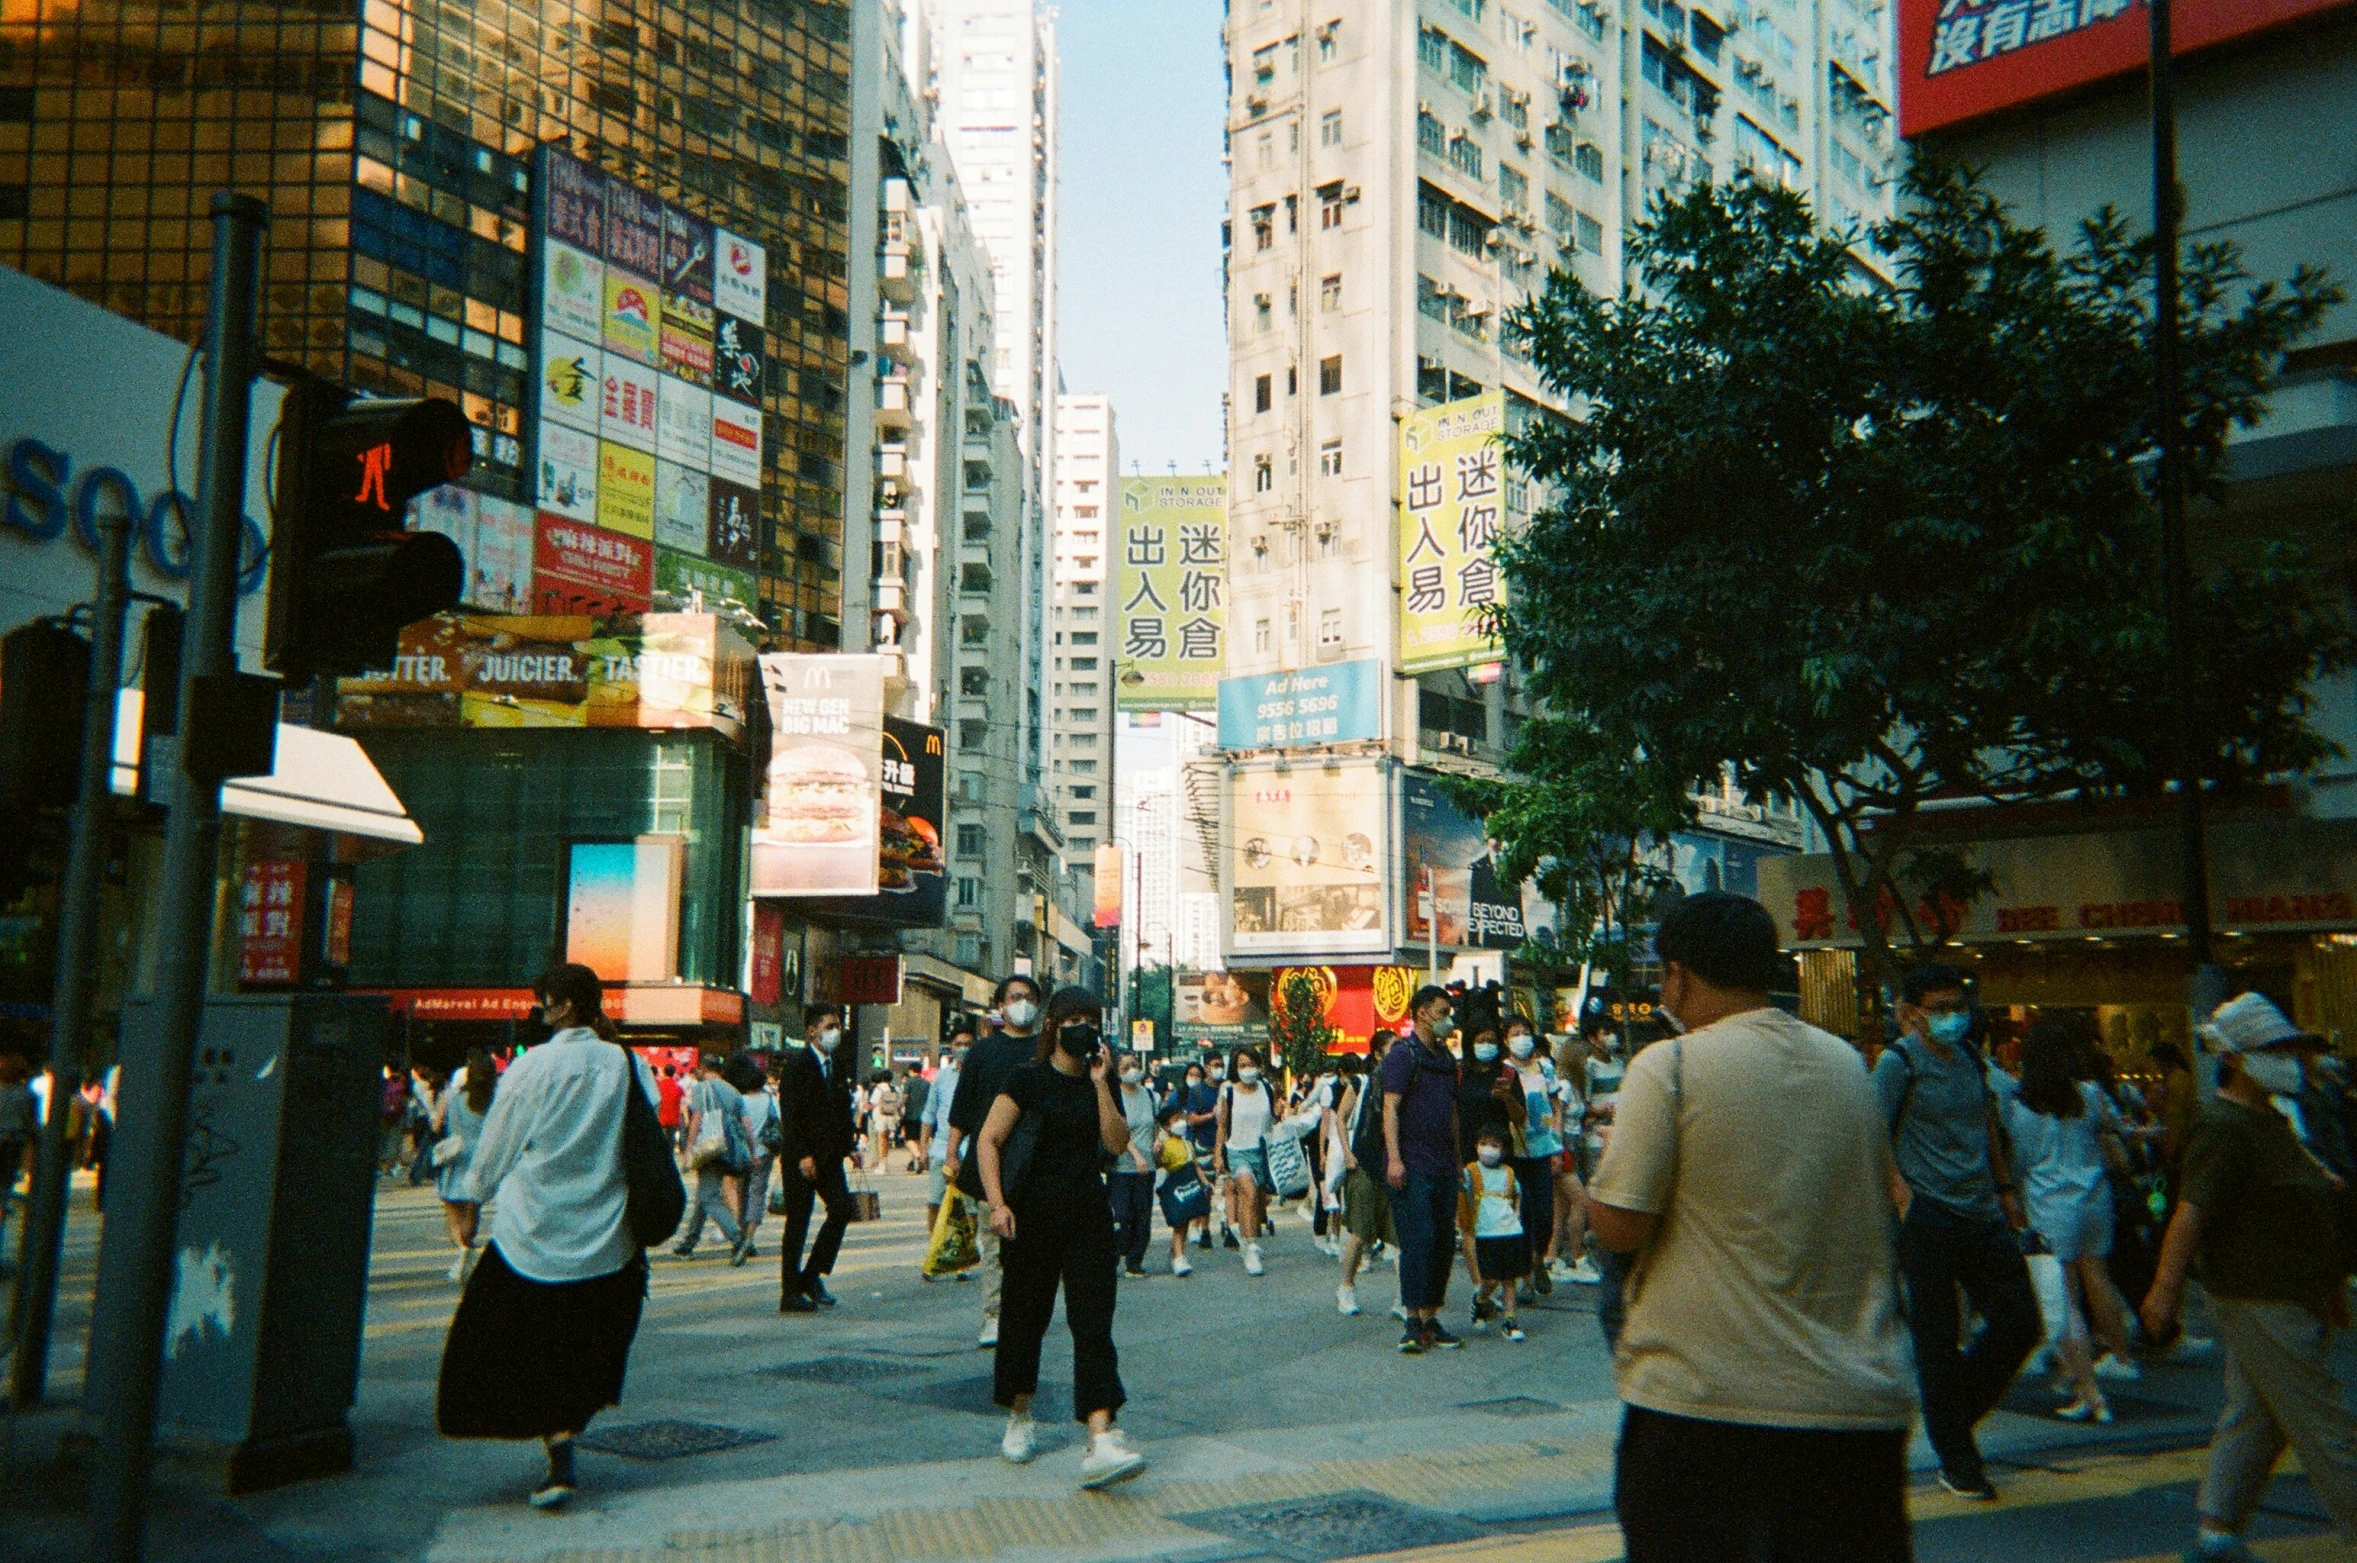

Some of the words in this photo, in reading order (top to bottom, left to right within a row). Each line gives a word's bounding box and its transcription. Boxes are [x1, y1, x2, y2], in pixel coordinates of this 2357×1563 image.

[1438, 417, 1498, 441] STORAGE
[1160, 497, 1221, 508] STORAGE
[1179, 523, 1221, 660] 迷你倉
[393, 654, 452, 686] TTER.
[478, 654, 578, 684] JUICIER.
[605, 654, 705, 682] TASTIER.
[1264, 678, 1289, 696] Ad
[1291, 676, 1328, 692] Here
[782, 698, 816, 715] NEW
[818, 698, 849, 715] GEN
[1257, 700, 1295, 719] 9556
[1298, 694, 1338, 714] 5696
[781, 716, 812, 734] BIG
[812, 715, 850, 735] MAC
[1473, 902, 1519, 922] BEYOND
[1469, 917, 1524, 938] EXPECTED
